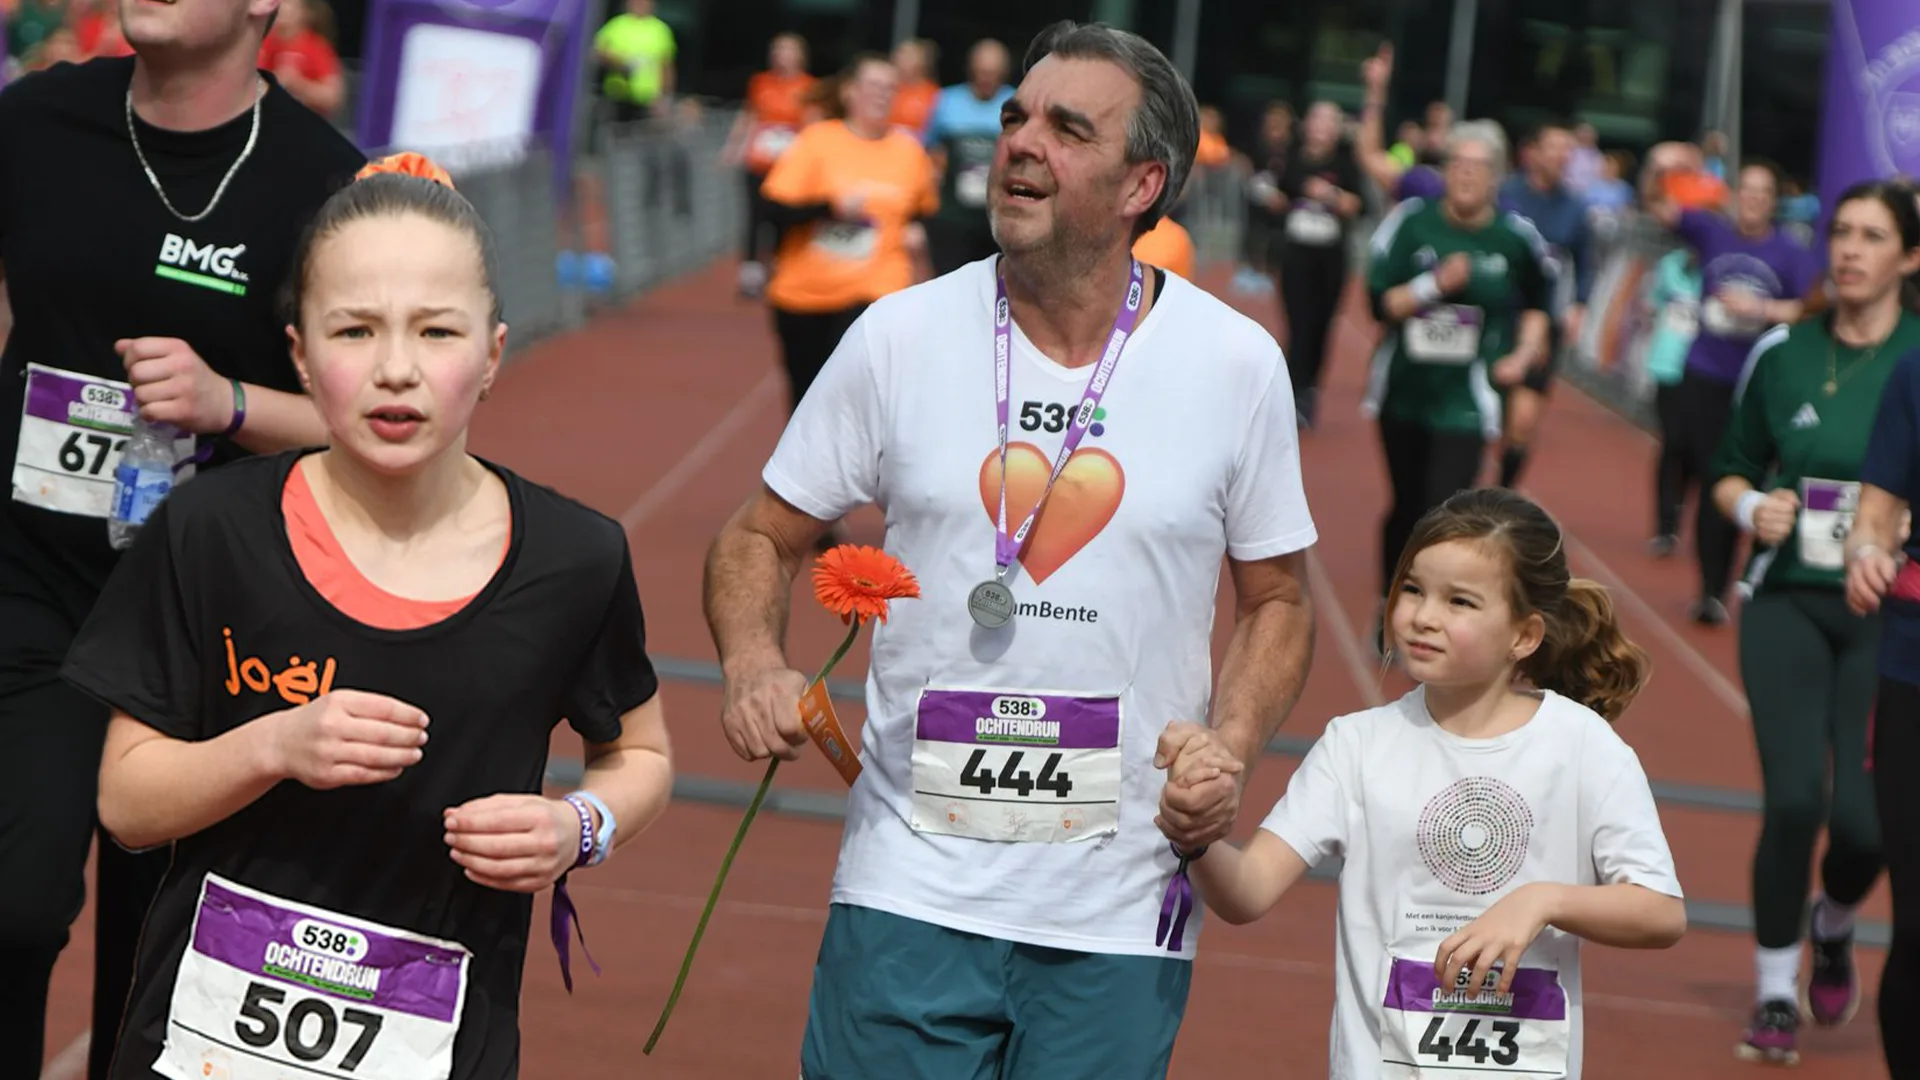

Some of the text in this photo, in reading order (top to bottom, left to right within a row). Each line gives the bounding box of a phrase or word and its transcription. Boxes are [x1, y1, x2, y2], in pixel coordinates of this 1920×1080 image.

[159, 233, 246, 276] BMG
[59, 431, 127, 476] 67
[976, 718, 1060, 737] OCHTENDRUN
[1000, 700, 1030, 716] 538
[960, 749, 1073, 797] 444
[302, 925, 347, 953] 538
[264, 941, 381, 992] OCHTENDRUN
[234, 981, 384, 1072] 507
[1418, 1017, 1520, 1066] 443
